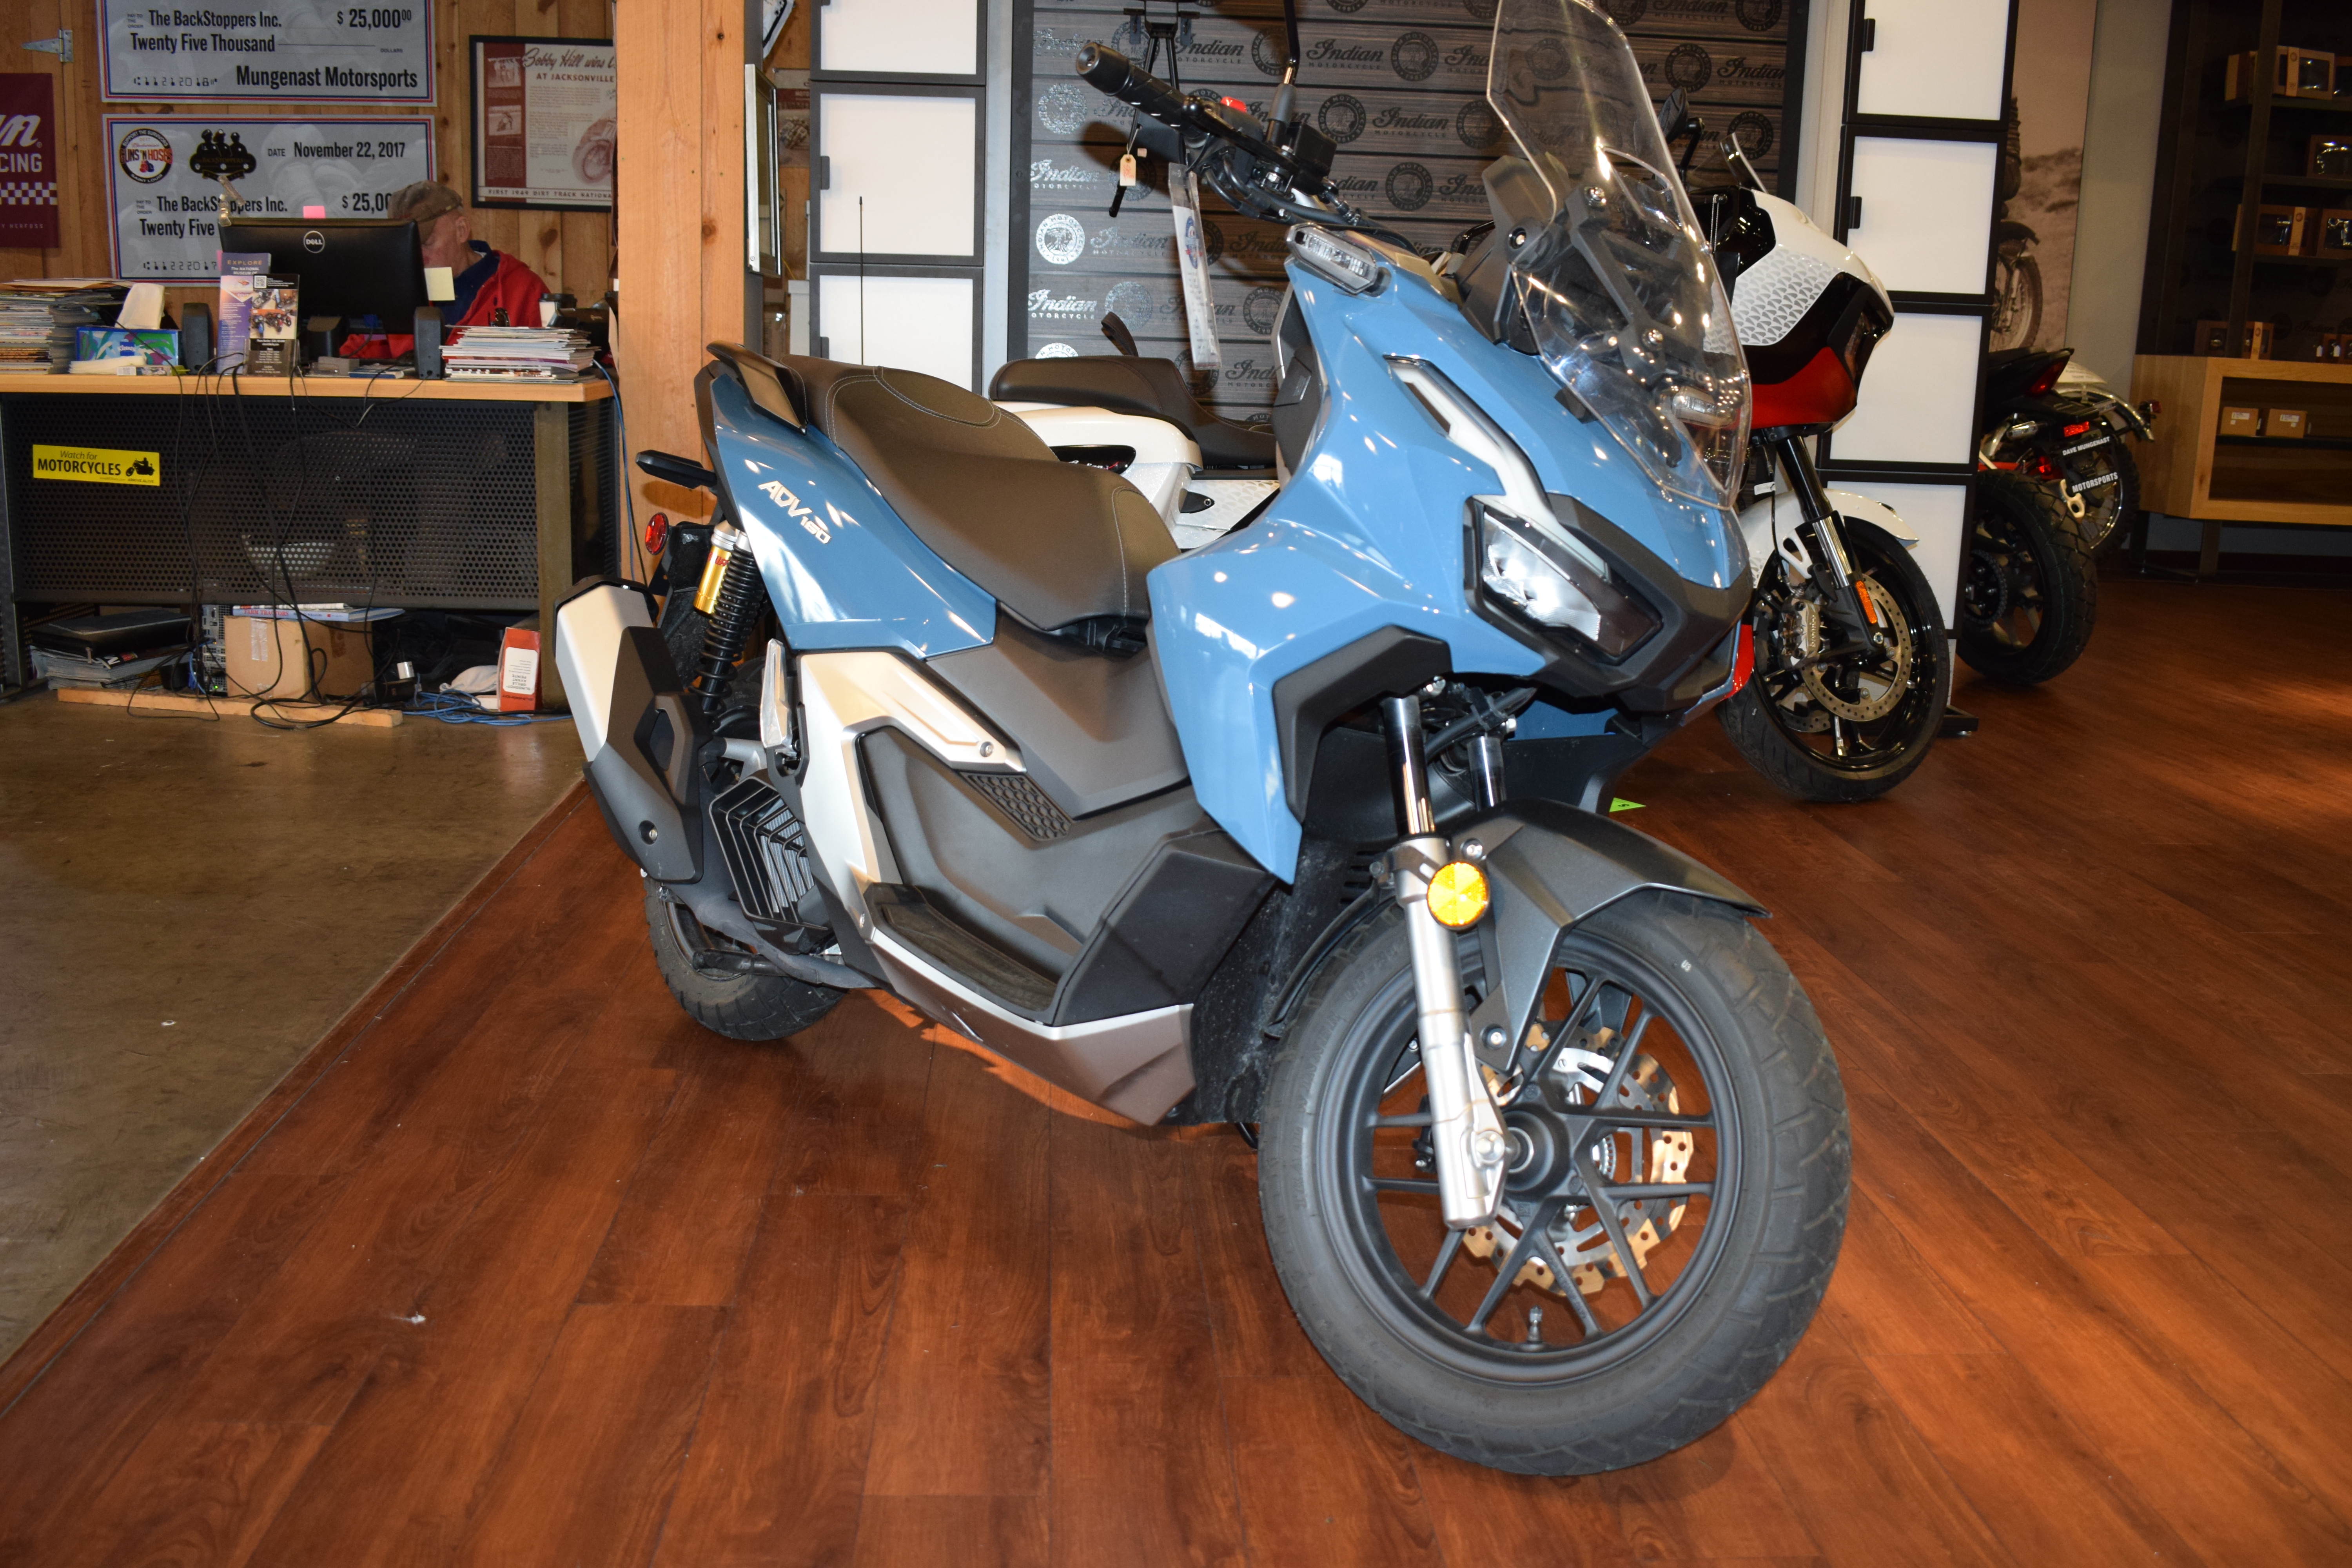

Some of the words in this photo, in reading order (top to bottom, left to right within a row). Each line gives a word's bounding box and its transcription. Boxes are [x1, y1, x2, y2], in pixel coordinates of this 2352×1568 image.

[149, 10, 170, 26] The
[174, 11, 256, 30] BackStoppers
[260, 11, 282, 27] Inc.
[337, 11, 343, 25] $
[131, 33, 178, 54] Twenty
[181, 33, 208, 51] Five
[211, 34, 275, 52] Thousand
[1306, 38, 1384, 62] Indian
[523, 47, 557, 70] Bobby
[560, 49, 584, 68] Hill
[236, 65, 321, 90] Mungenast
[325, 66, 418, 91] Motorsports
[551, 73, 614, 83] JACKSONVILLE
[1372, 107, 1450, 130] Indian
[294, 142, 353, 157] November
[356, 142, 375, 159] 22,
[378, 142, 405, 158] 2017
[157, 196, 178, 212] The
[181, 197, 263, 215] BackSppers
[266, 197, 287, 212] Inc.
[342, 196, 348, 209] $
[140, 218, 185, 239] Twenty
[189, 219, 215, 236] Five
[1090, 226, 1169, 249] Indian
[1028, 289, 1097, 312] Indian
[60, 450, 85, 460] Watch
[86, 452, 98, 460] for
[2062, 446, 2077, 456] DAVE
[2077, 436, 2111, 452] MUNGENAST
[38, 458, 121, 476] MOTORCYCLES
[2071, 471, 2118, 494] MOTORSPORTS
[758, 480, 813, 518] ADV
[800, 515, 832, 544] 160
